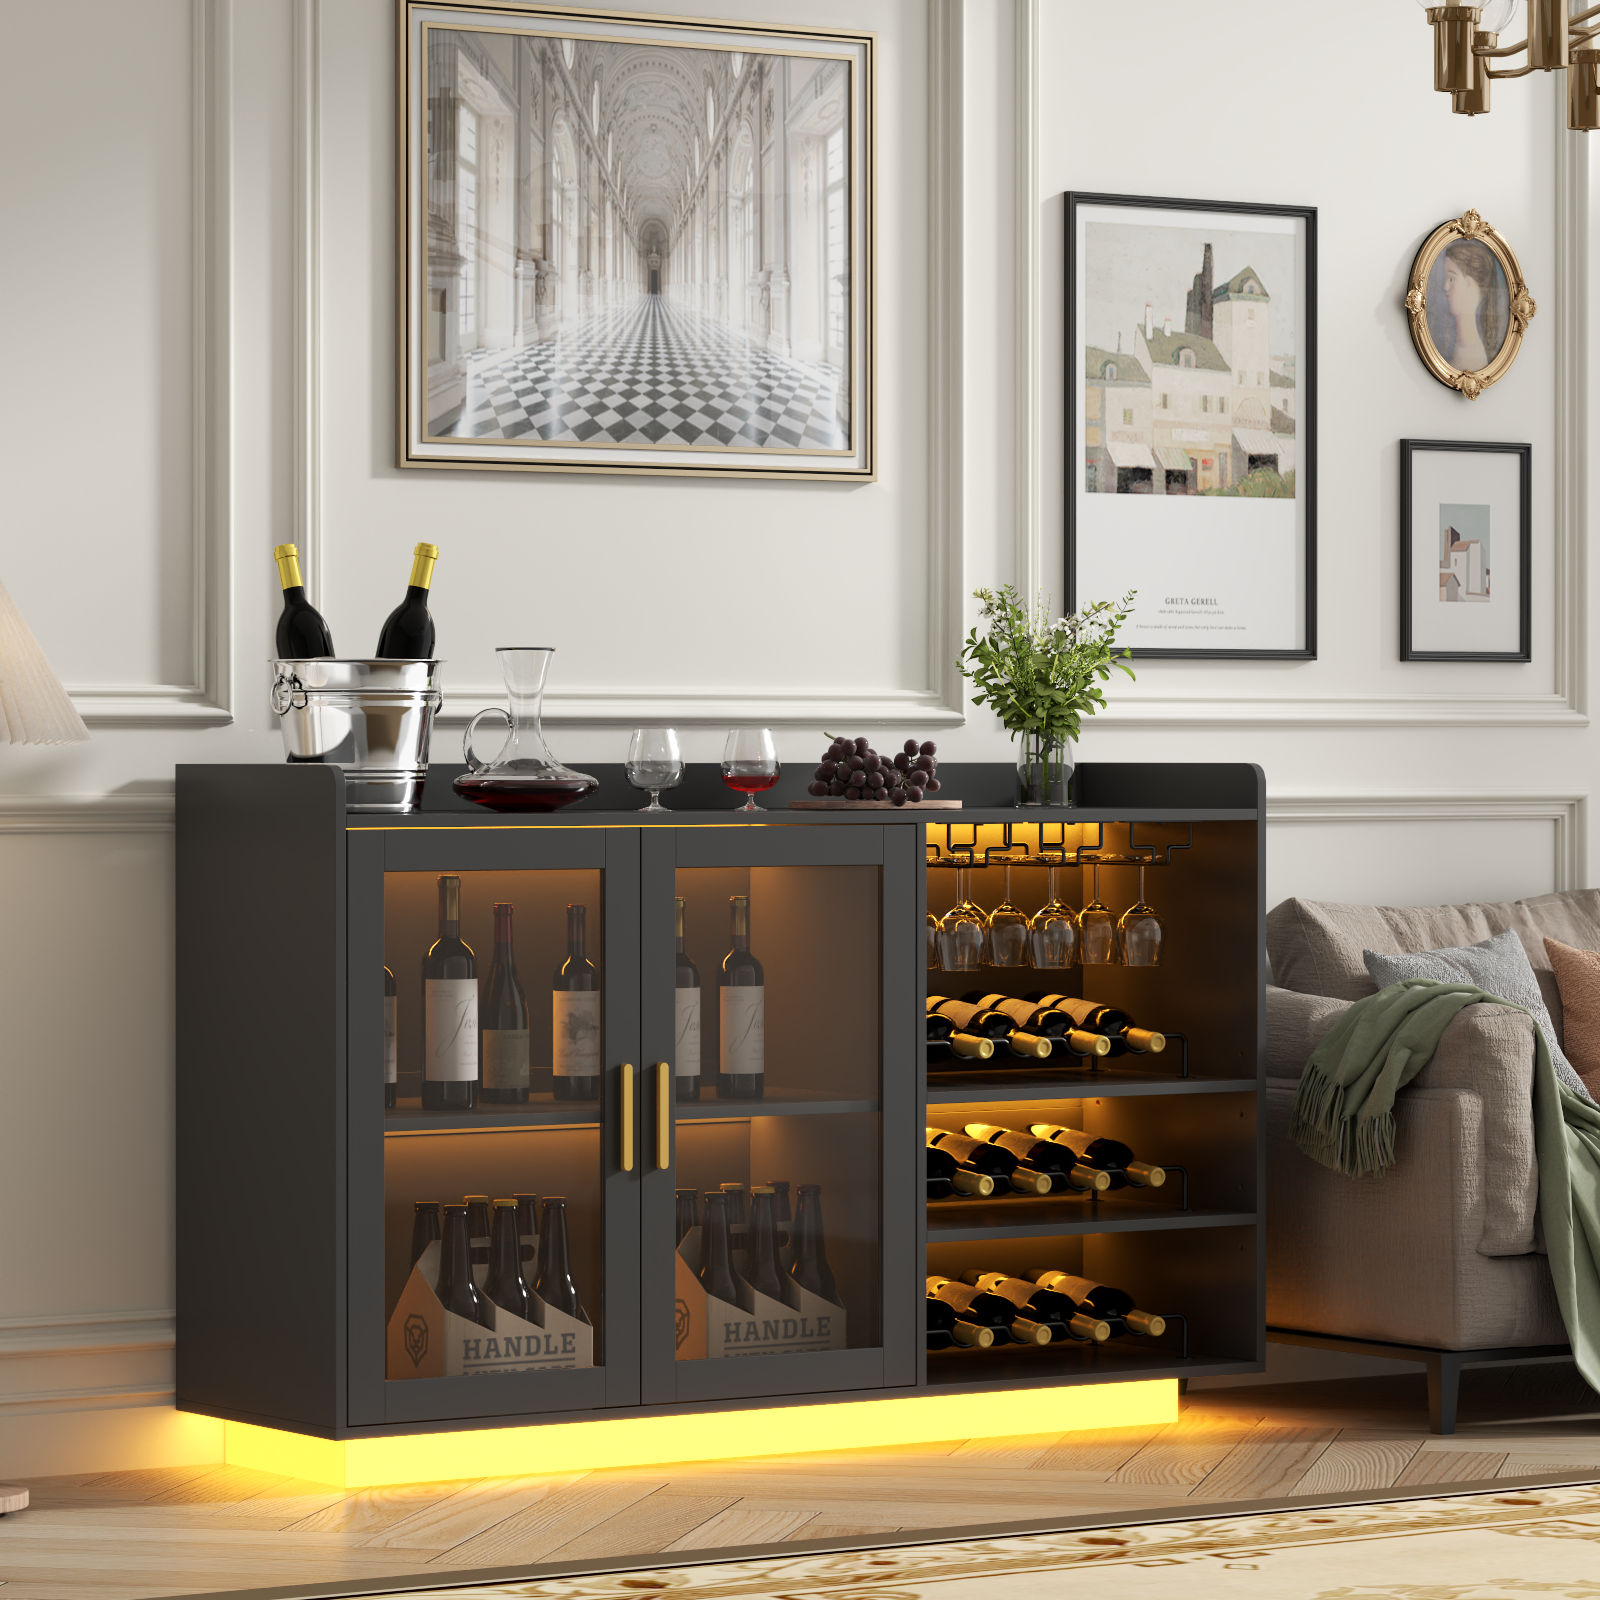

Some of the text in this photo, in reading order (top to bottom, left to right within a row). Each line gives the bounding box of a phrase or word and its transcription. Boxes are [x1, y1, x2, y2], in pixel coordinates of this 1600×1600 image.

[1165, 597, 1218, 606] GRETA GERELL
[724, 1316, 831, 1343] HANDLE
[463, 1332, 576, 1360] HANDLE
